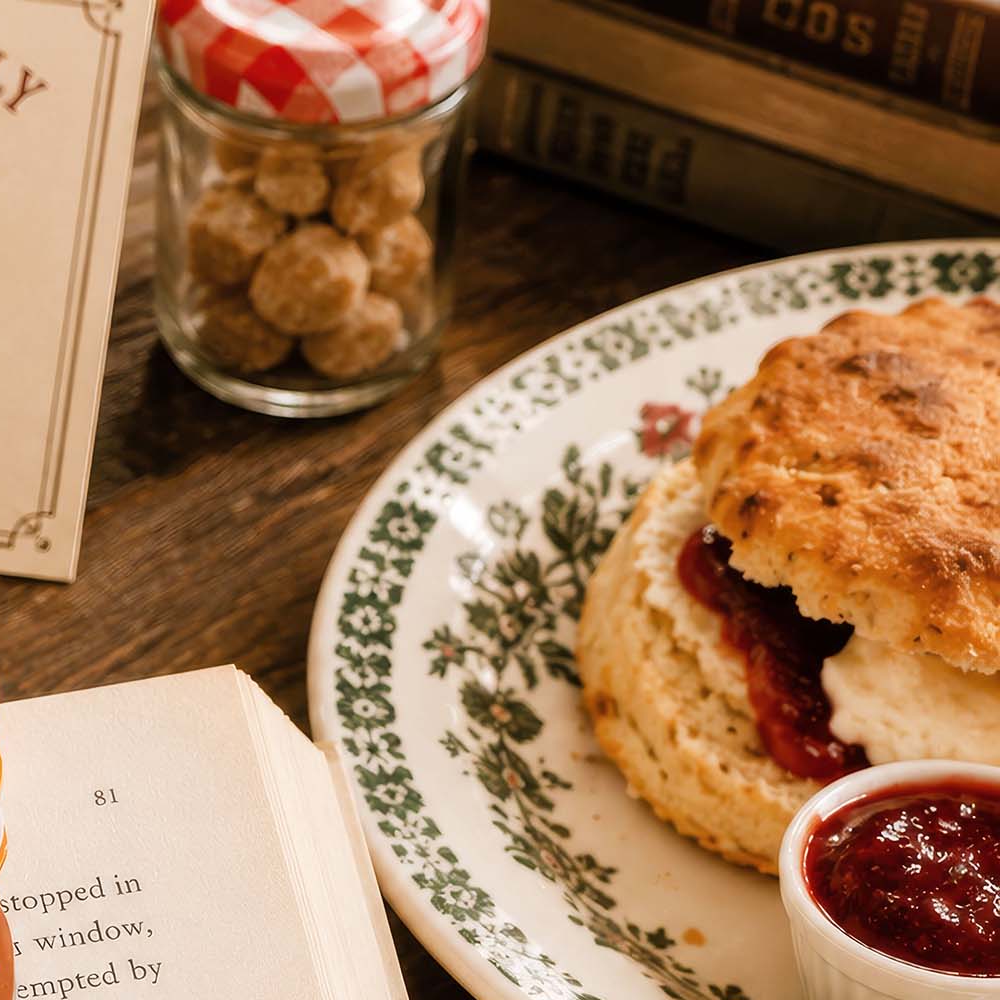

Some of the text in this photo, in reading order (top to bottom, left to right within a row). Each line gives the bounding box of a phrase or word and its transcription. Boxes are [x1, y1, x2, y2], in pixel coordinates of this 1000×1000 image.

[93, 788, 119, 807] 81
[0, 874, 142, 915] stopped in
[32, 919, 153, 951] window,
[127, 958, 162, 985] by
